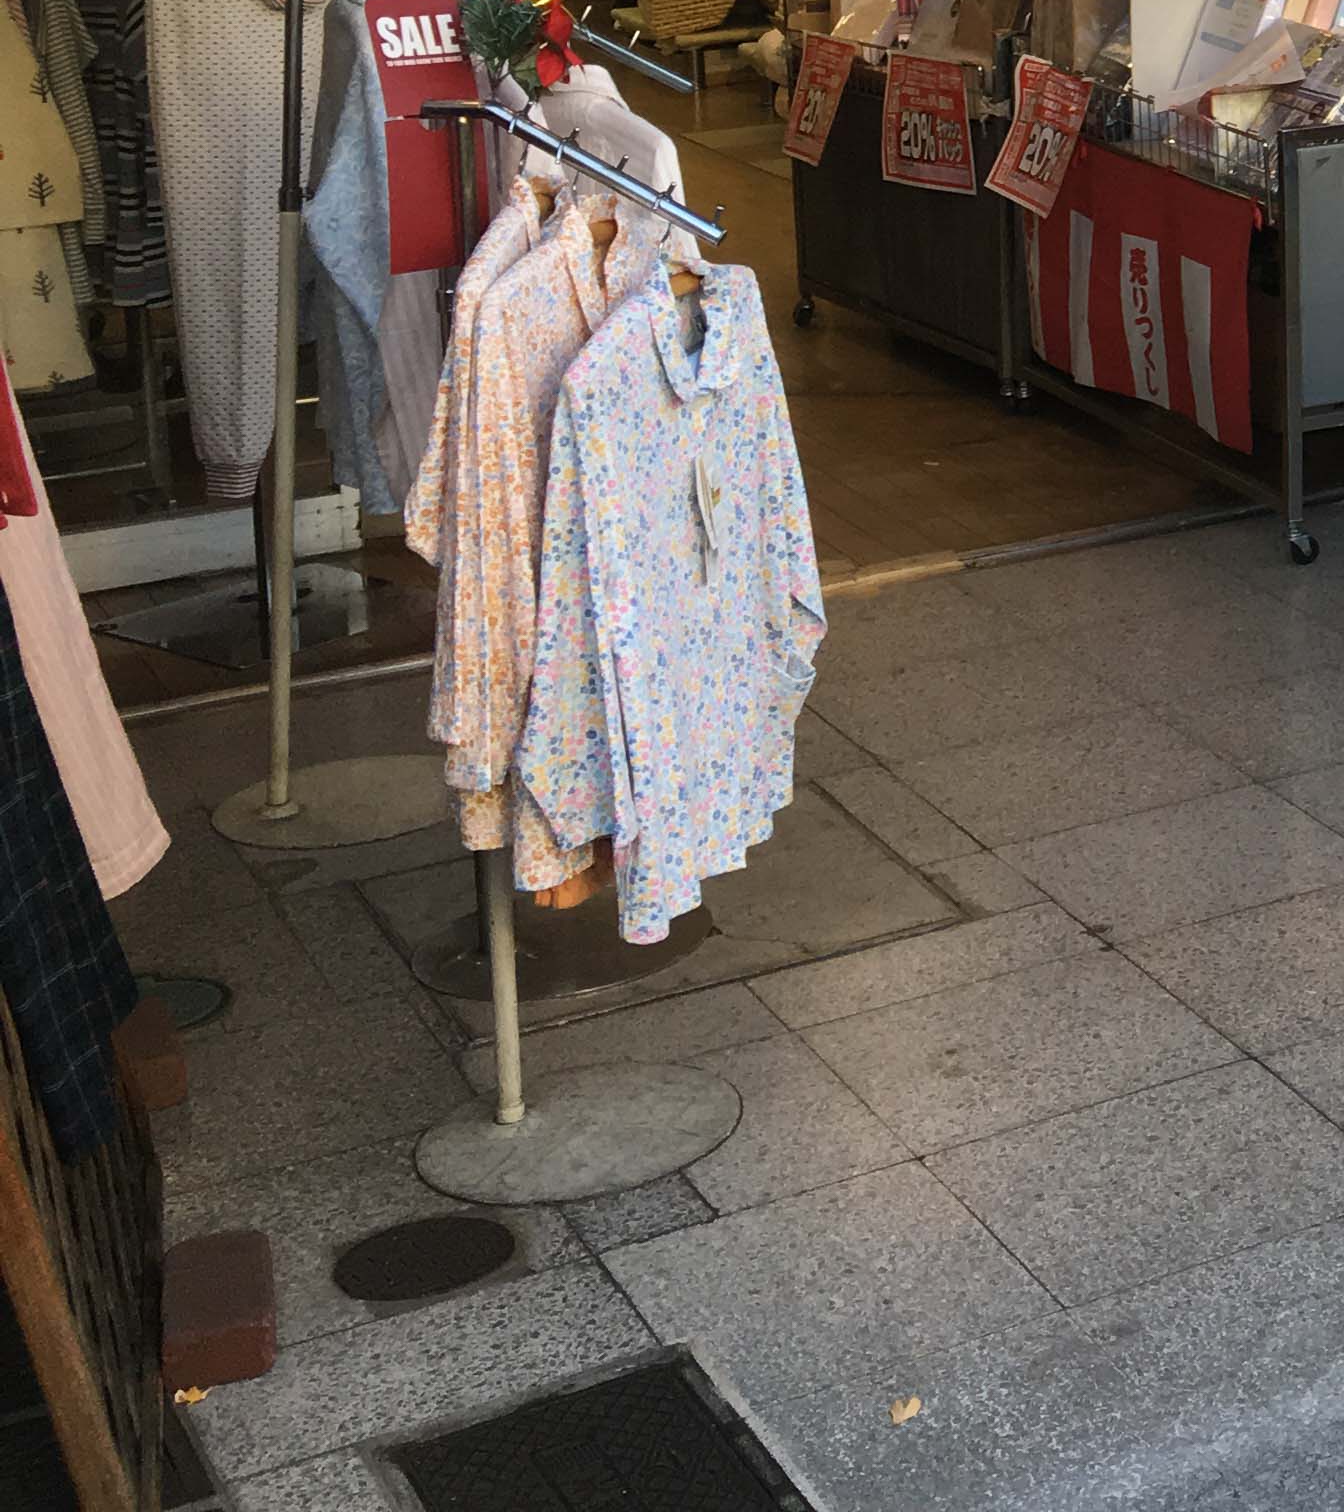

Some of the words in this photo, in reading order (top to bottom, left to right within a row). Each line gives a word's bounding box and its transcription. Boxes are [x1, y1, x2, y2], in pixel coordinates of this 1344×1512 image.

[376, 14, 460, 59] SALE
[901, 111, 935, 161] 20%
[1129, 248, 1160, 396] 売りつくし
